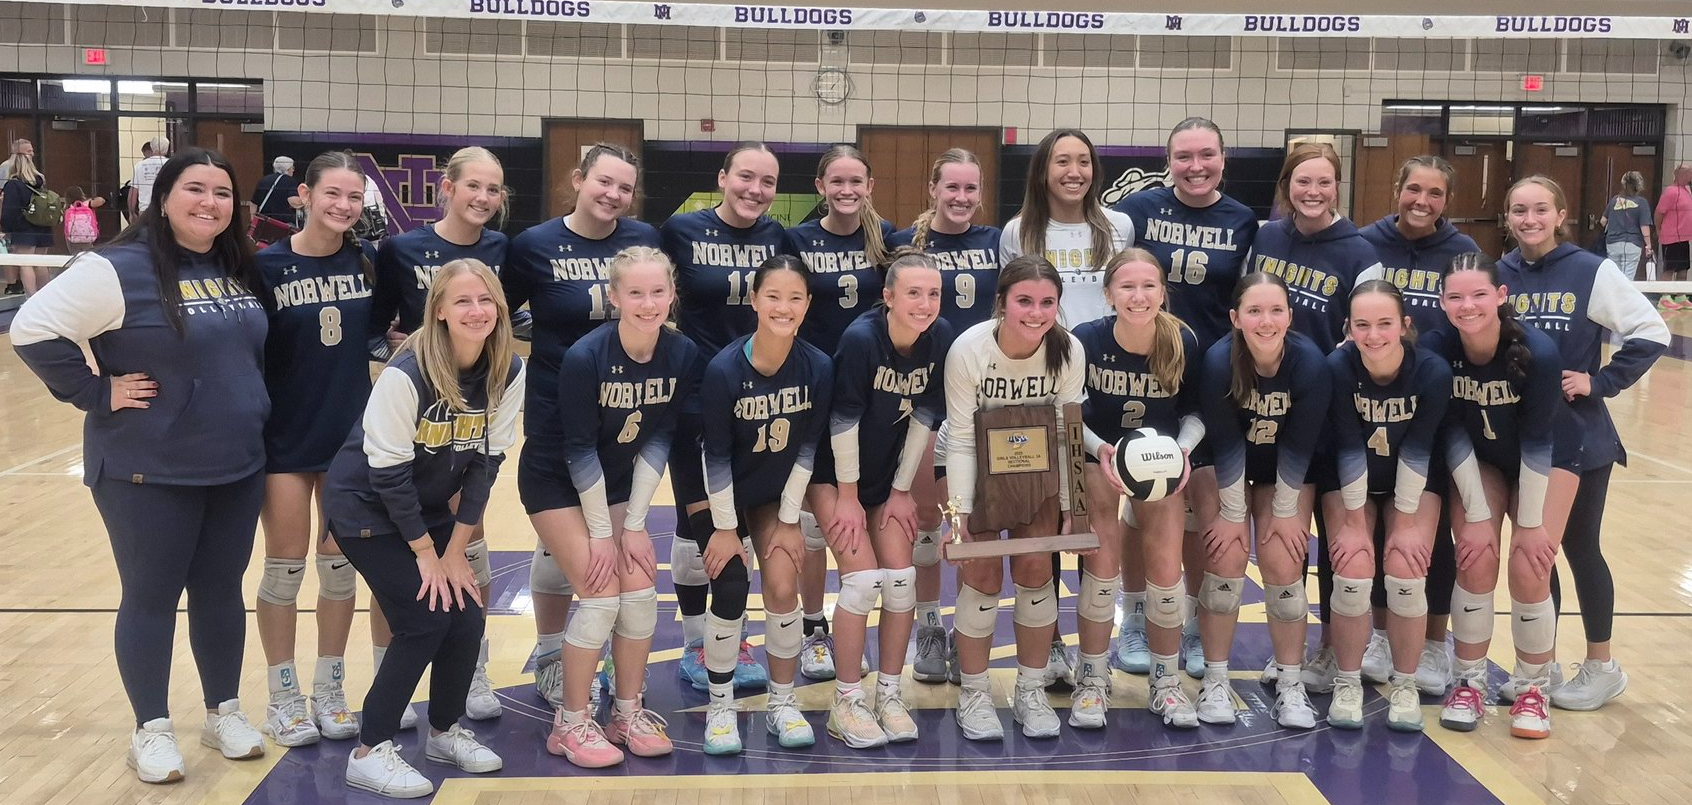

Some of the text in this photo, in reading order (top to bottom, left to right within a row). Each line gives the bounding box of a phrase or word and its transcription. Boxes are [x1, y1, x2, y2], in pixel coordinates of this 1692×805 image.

[470, 0, 590, 17] BULLDOGS
[734, 6, 852, 25] BULLDOGS
[988, 11, 1104, 29] BULLDOGS
[1244, 15, 1360, 32] BULLDOGS
[1496, 17, 1611, 33] BULLDOGS
[1144, 217, 1237, 251] NORWELL
[550, 257, 616, 281] NORW
[800, 250, 872, 273] NORWE
[1168, 248, 1208, 285] 16
[273, 273, 373, 311] NORWELL
[838, 274, 858, 309] 3
[955, 273, 976, 309] 9
[1382, 267, 1443, 296] IGHT
[319, 306, 342, 347] 8
[1088, 363, 1171, 399] NORWE
[617, 409, 643, 444] 6
[1121, 400, 1146, 428] 2
[752, 417, 791, 453] 19
[1245, 418, 1279, 445] 12
[1367, 426, 1390, 457] 4
[1071, 426, 1086, 513] IHSAA
[1140, 451, 1175, 462] Wilson
